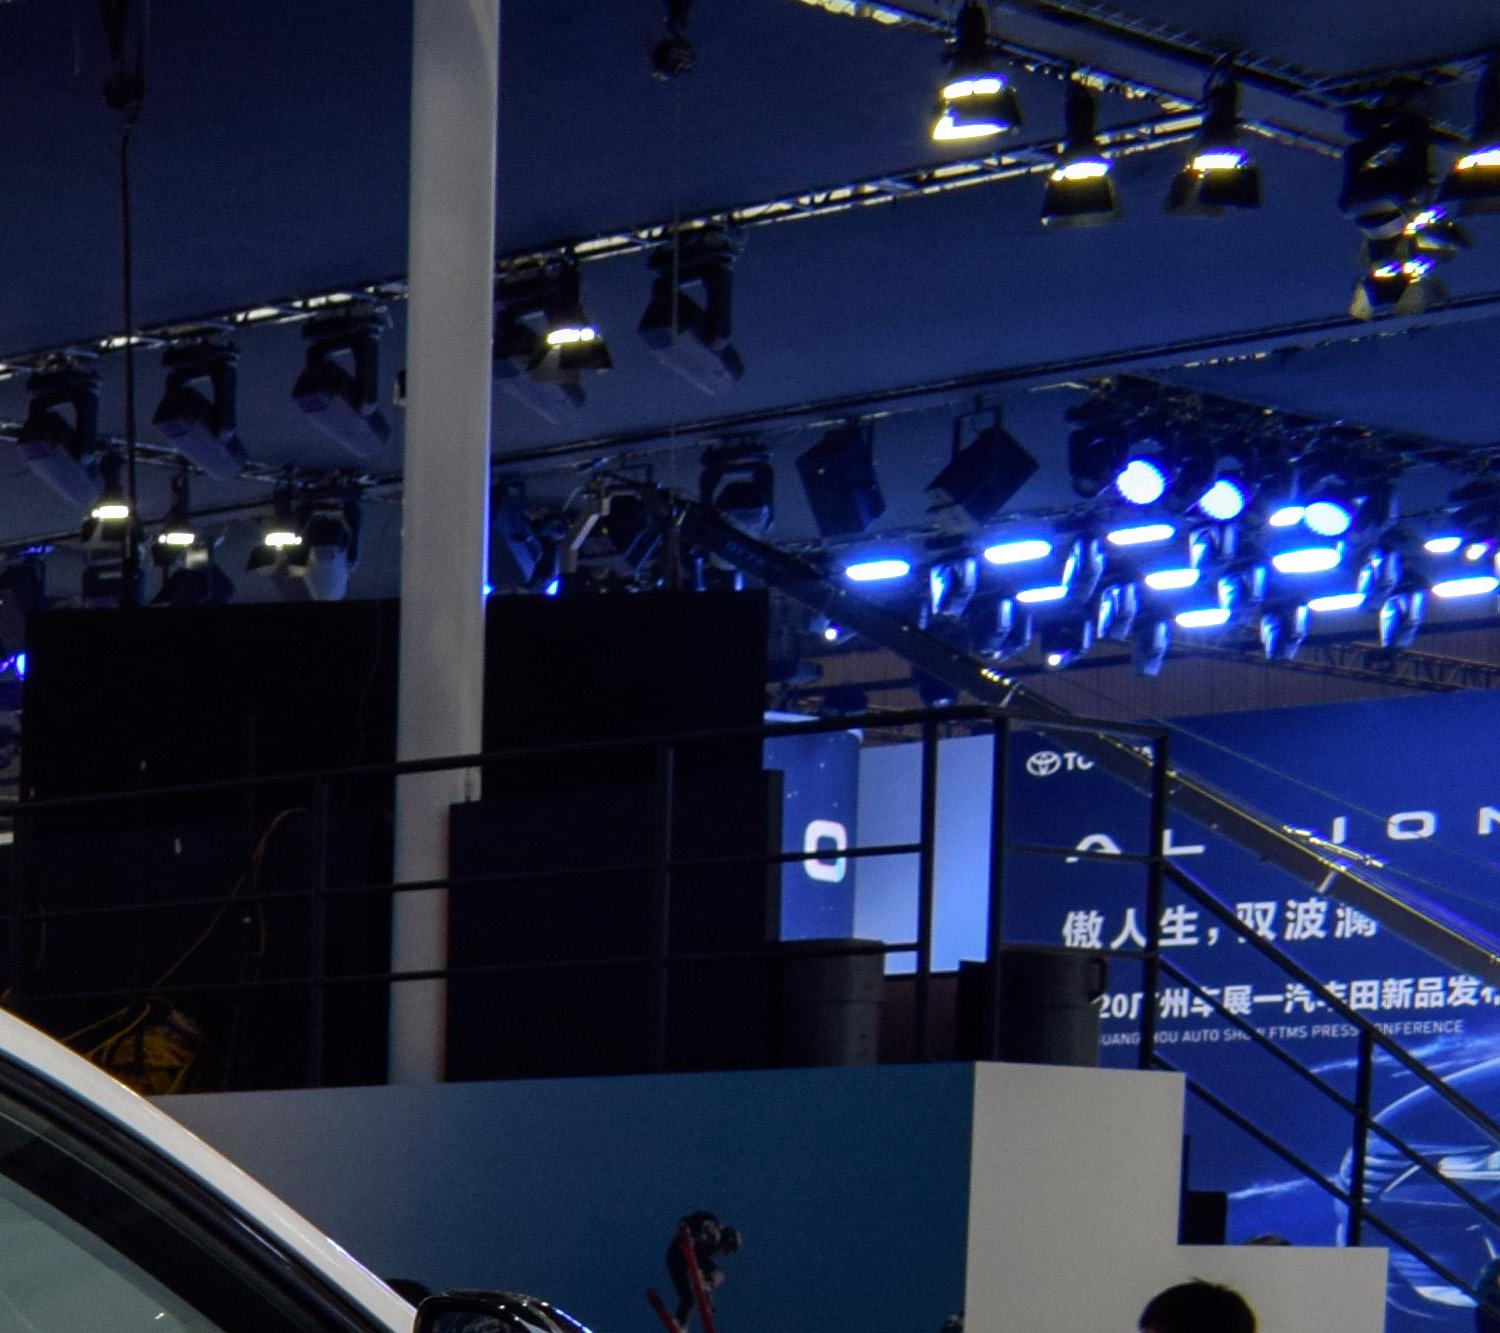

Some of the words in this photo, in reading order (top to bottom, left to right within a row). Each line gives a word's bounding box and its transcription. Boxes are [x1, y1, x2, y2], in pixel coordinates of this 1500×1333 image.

[1181, 1028, 1220, 1044] AUTO
[1311, 1022, 1360, 1039] PRESS
[1372, 1018, 1464, 1036] ONFERENCE
